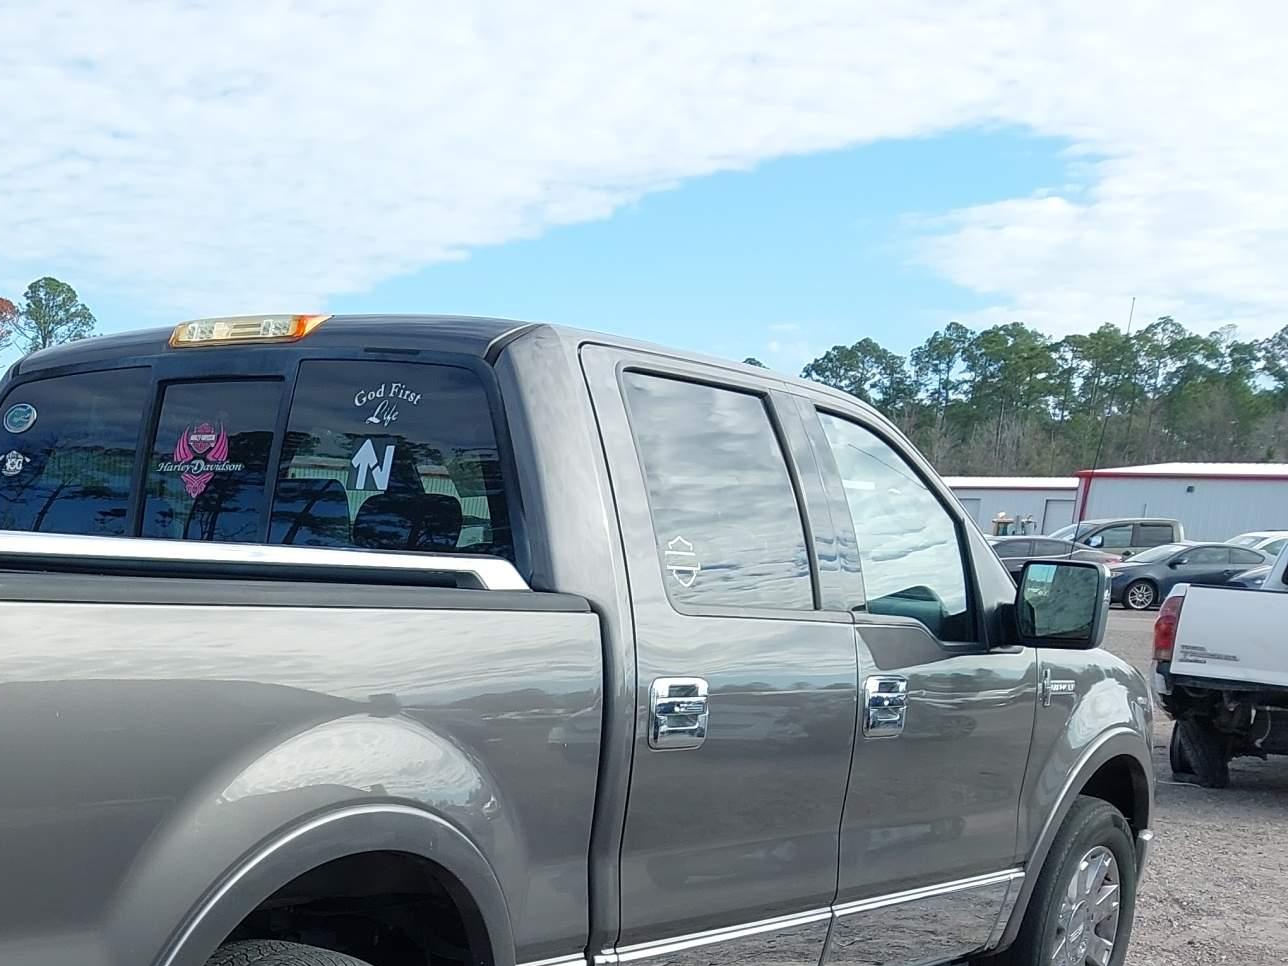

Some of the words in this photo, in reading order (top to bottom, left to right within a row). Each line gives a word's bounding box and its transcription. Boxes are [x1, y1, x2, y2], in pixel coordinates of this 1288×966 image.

[355, 384, 385, 406] God
[389, 383, 421, 404] First
[365, 400, 399, 427] Life
